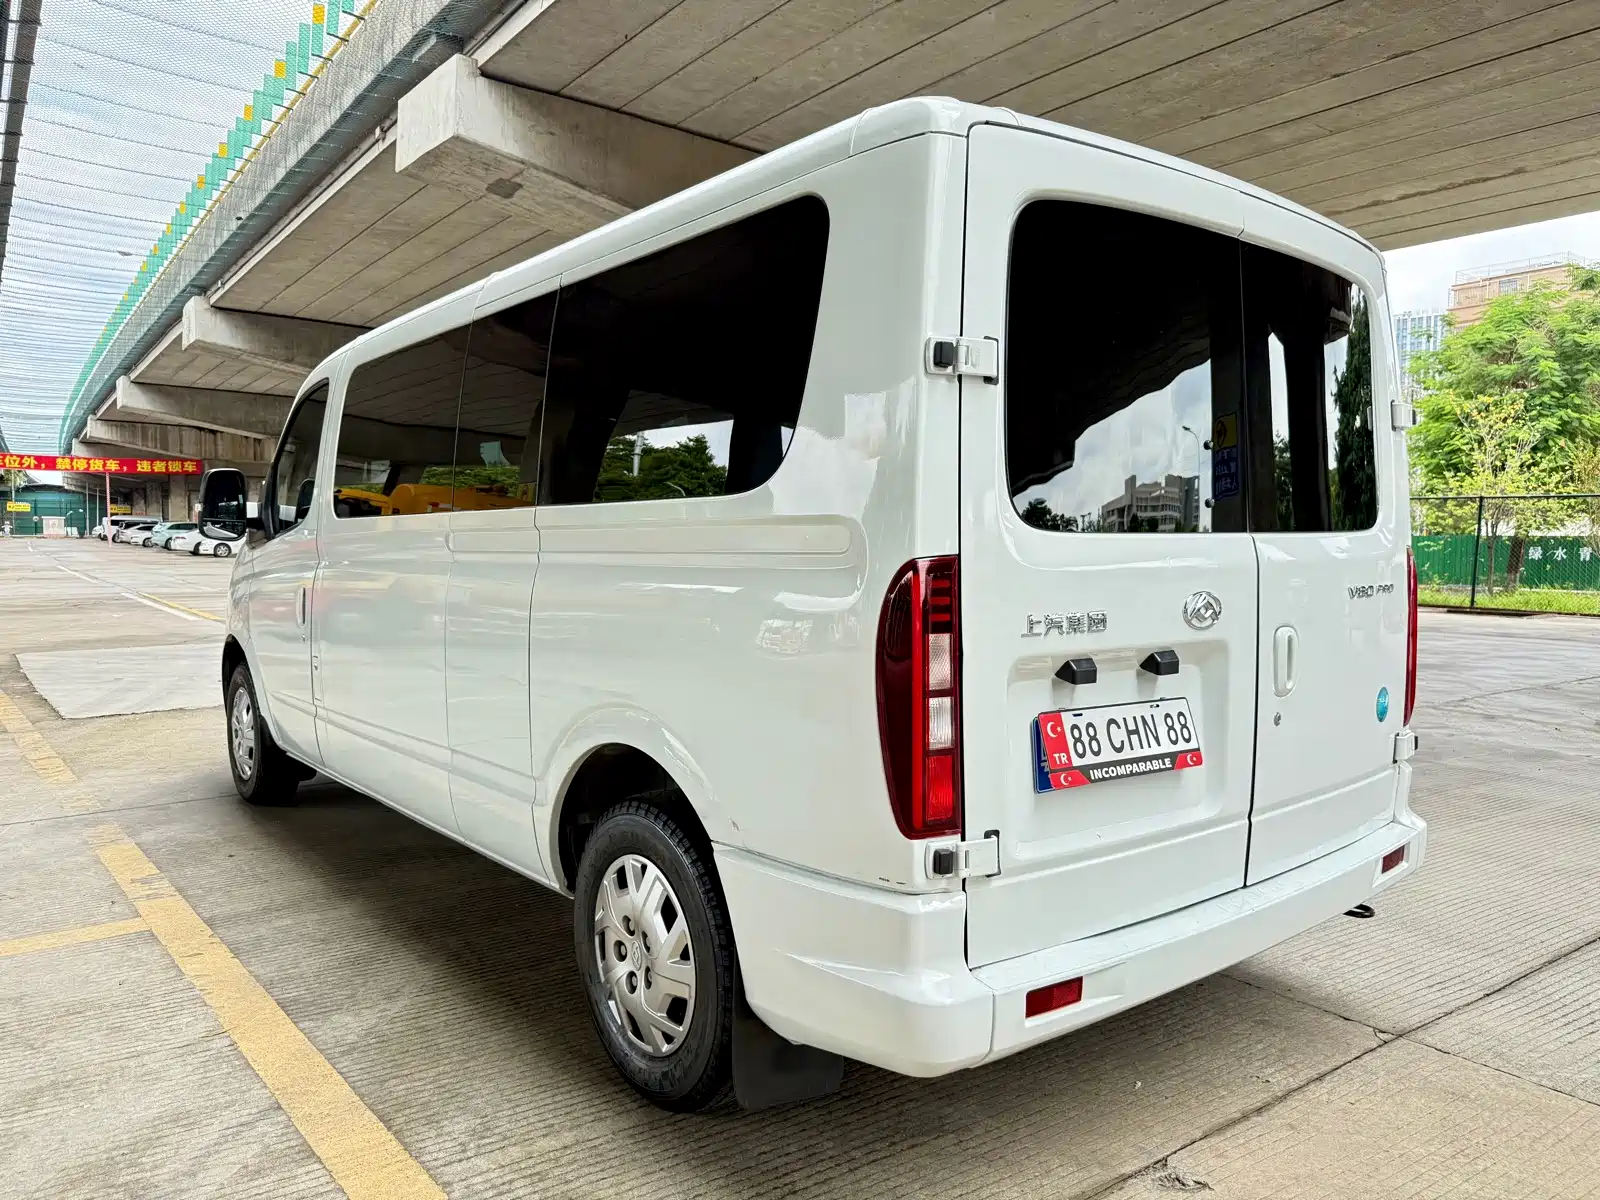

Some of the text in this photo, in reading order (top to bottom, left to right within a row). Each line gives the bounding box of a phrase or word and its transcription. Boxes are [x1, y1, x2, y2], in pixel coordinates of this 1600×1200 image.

[0, 455, 197, 472] 位外，禁停货车，违者锁车
[1070, 721, 1102, 760] 88
[1106, 713, 1162, 754] CHN
[1163, 711, 1192, 746] 88
[1053, 752, 1069, 765] TR
[1089, 757, 1172, 780] INCOMPARABLE
